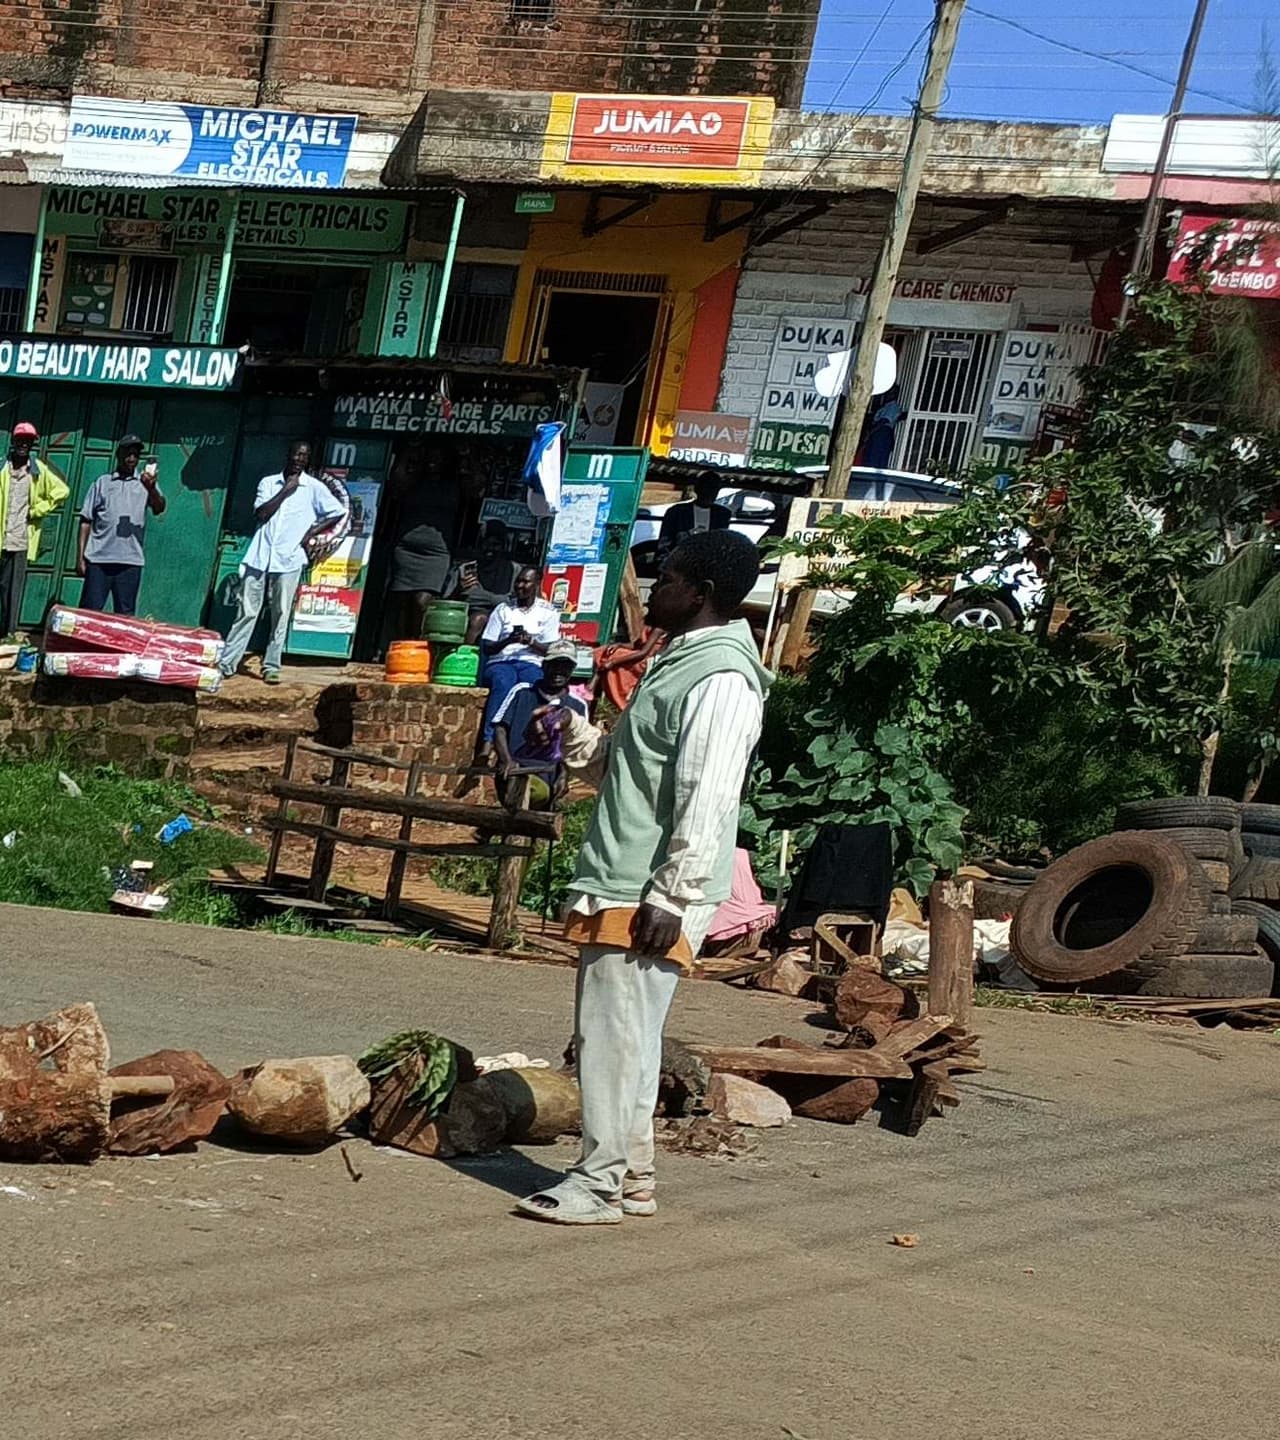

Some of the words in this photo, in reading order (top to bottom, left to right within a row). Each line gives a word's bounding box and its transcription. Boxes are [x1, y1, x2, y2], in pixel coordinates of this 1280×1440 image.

[72, 122, 172, 146] POWERMAX
[199, 110, 343, 146] MICHAEL
[231, 138, 302, 170] STAR
[197, 161, 329, 187] ELECTRICALS
[46, 188, 149, 219] MICHAEL
[161, 195, 221, 223] STAR
[237, 200, 390, 233] ELECTRICALS
[949, 282, 1018, 304] CHEMIST
[780, 326, 846, 347] DUKA
[16, 340, 101, 377] BEAUTY
[100, 345, 151, 382] HAIR
[161, 349, 238, 388] SALON
[795, 360, 815, 379] LA
[334, 396, 414, 416] MAYAKA
[490, 404, 553, 422] PARTS
[767, 390, 830, 412] DAWA
